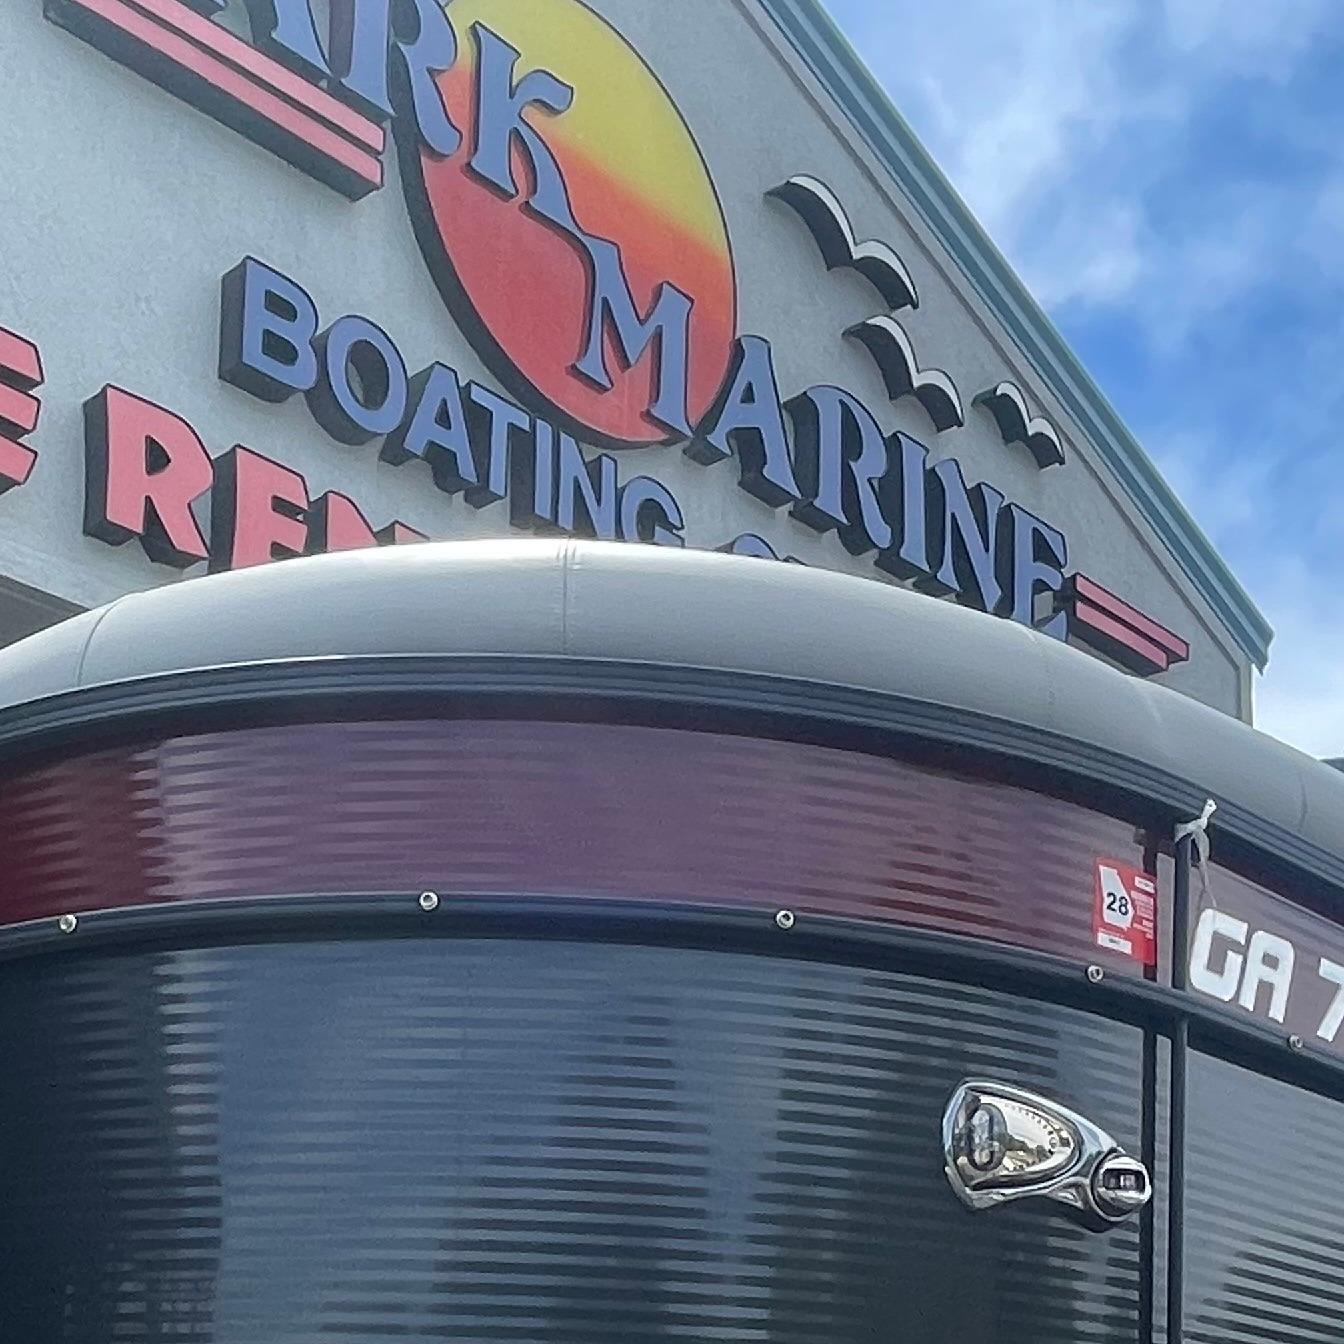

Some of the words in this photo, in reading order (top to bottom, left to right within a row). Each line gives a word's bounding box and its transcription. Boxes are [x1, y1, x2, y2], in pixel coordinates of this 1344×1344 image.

[242, 256, 686, 546] BOATING
[570, 236, 1068, 642] MARINE
[1106, 892, 1129, 916] 28
[1189, 908, 1295, 1024] GA
